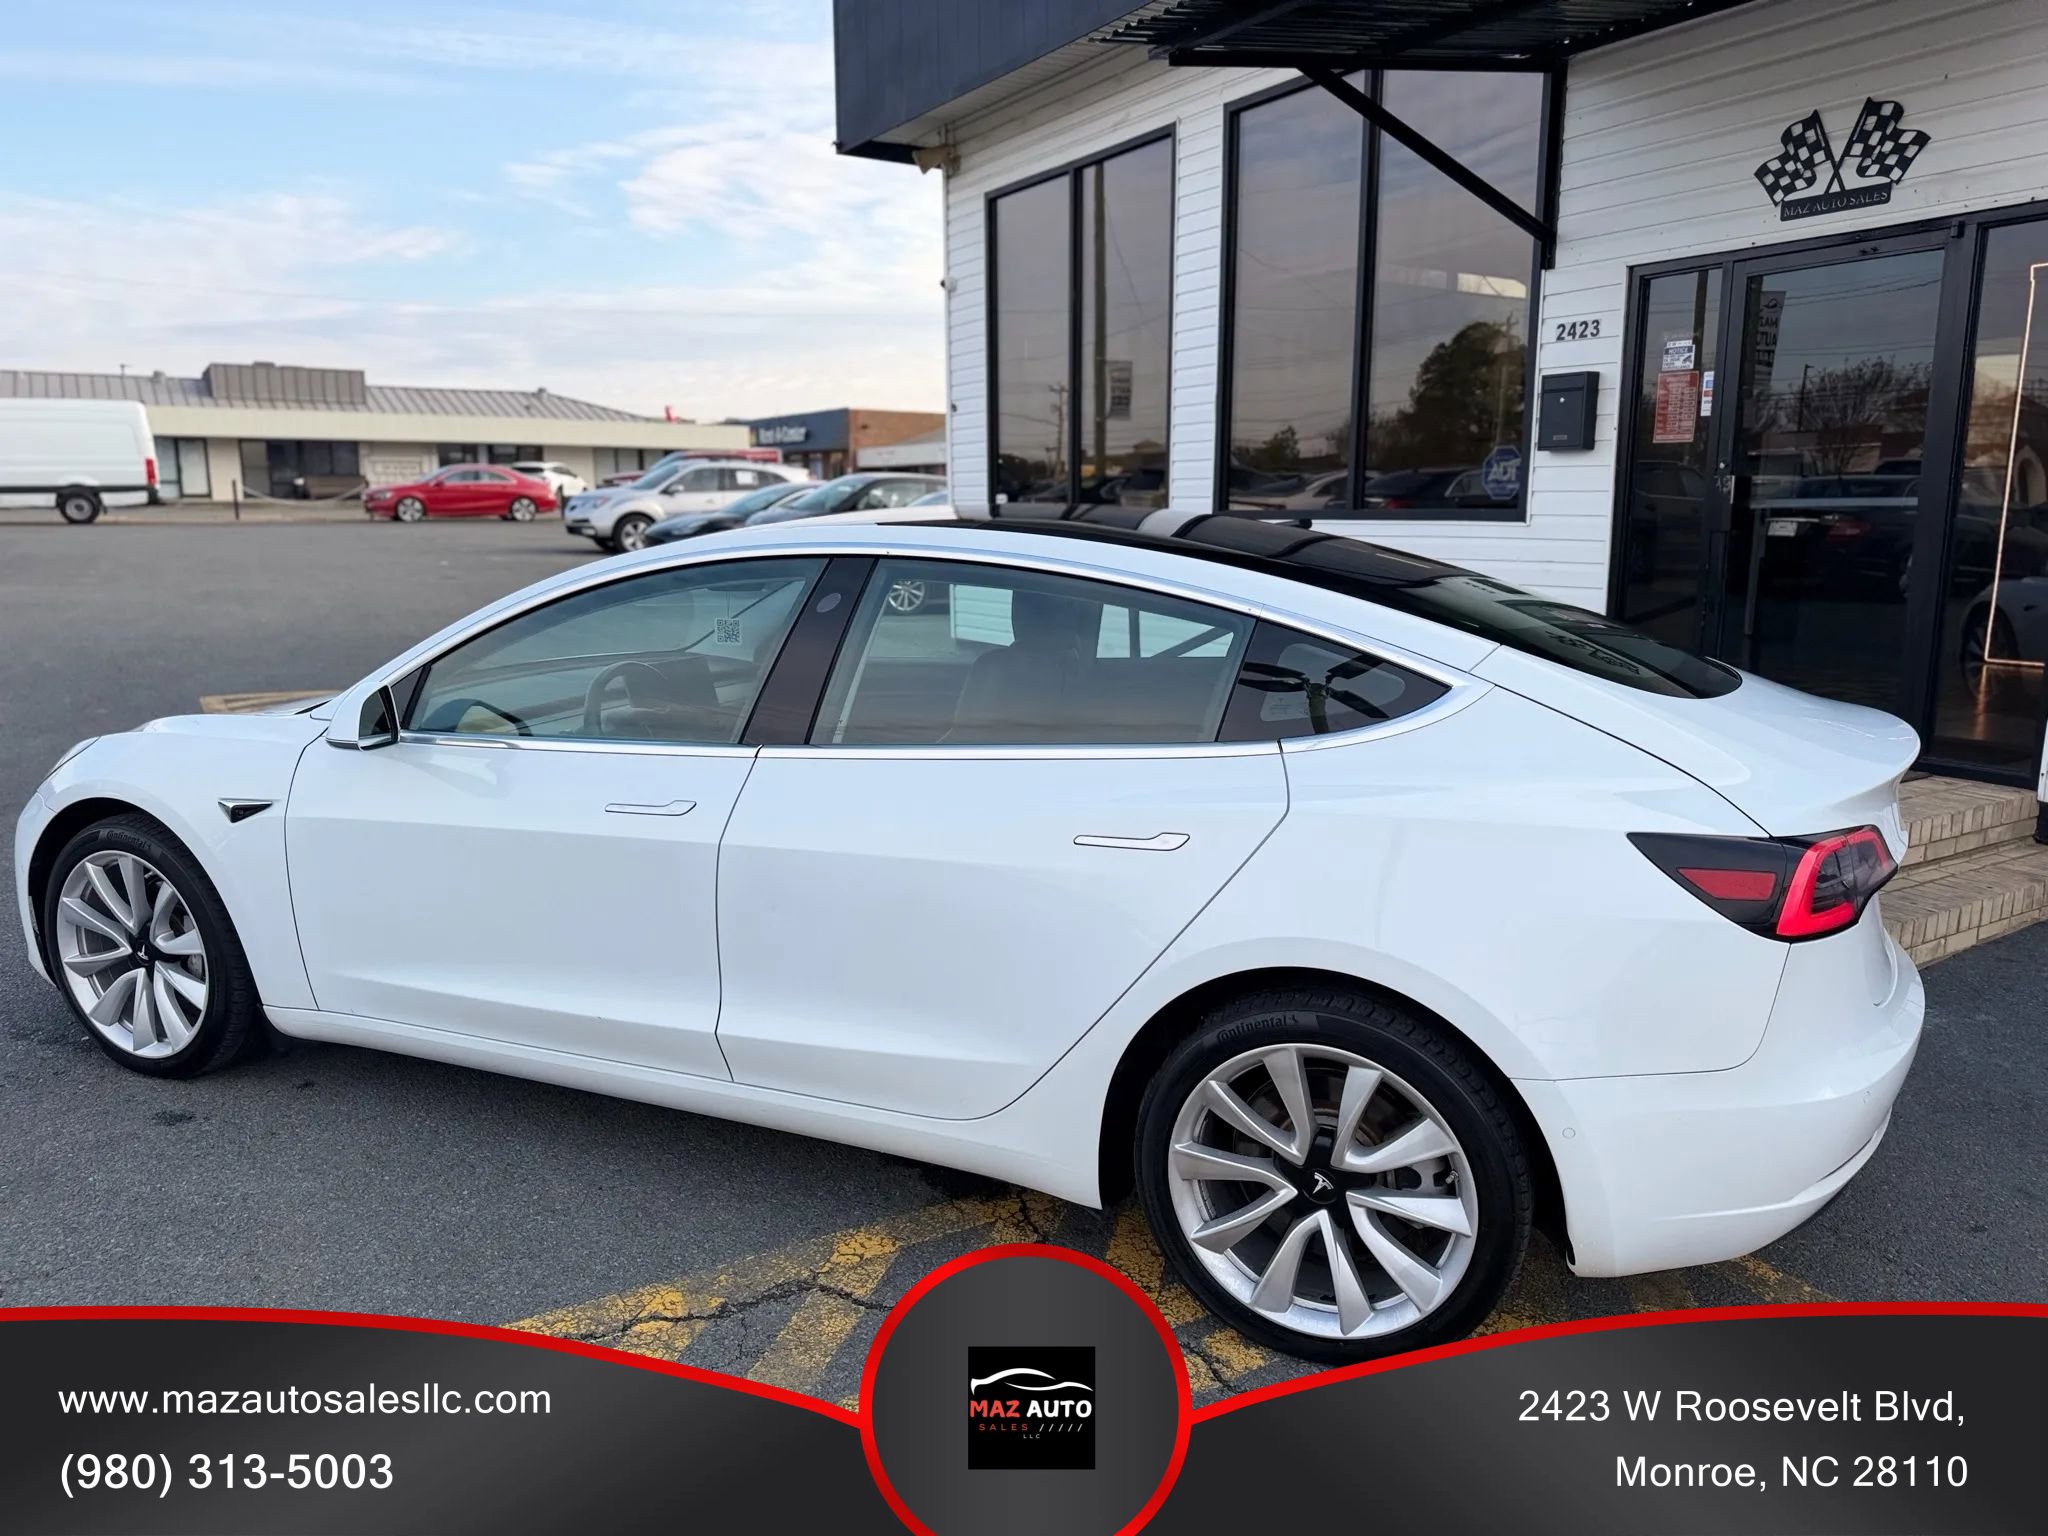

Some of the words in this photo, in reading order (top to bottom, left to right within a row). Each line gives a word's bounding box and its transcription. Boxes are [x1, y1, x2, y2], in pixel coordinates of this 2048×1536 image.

[1783, 202, 1811, 217] MAZ
[1812, 197, 1848, 212] AUTO
[1848, 191, 1888, 205] SALES
[1556, 318, 1601, 341] 2423
[1487, 458, 1522, 481] ADT
[1217, 1016, 1287, 1042] Continental
